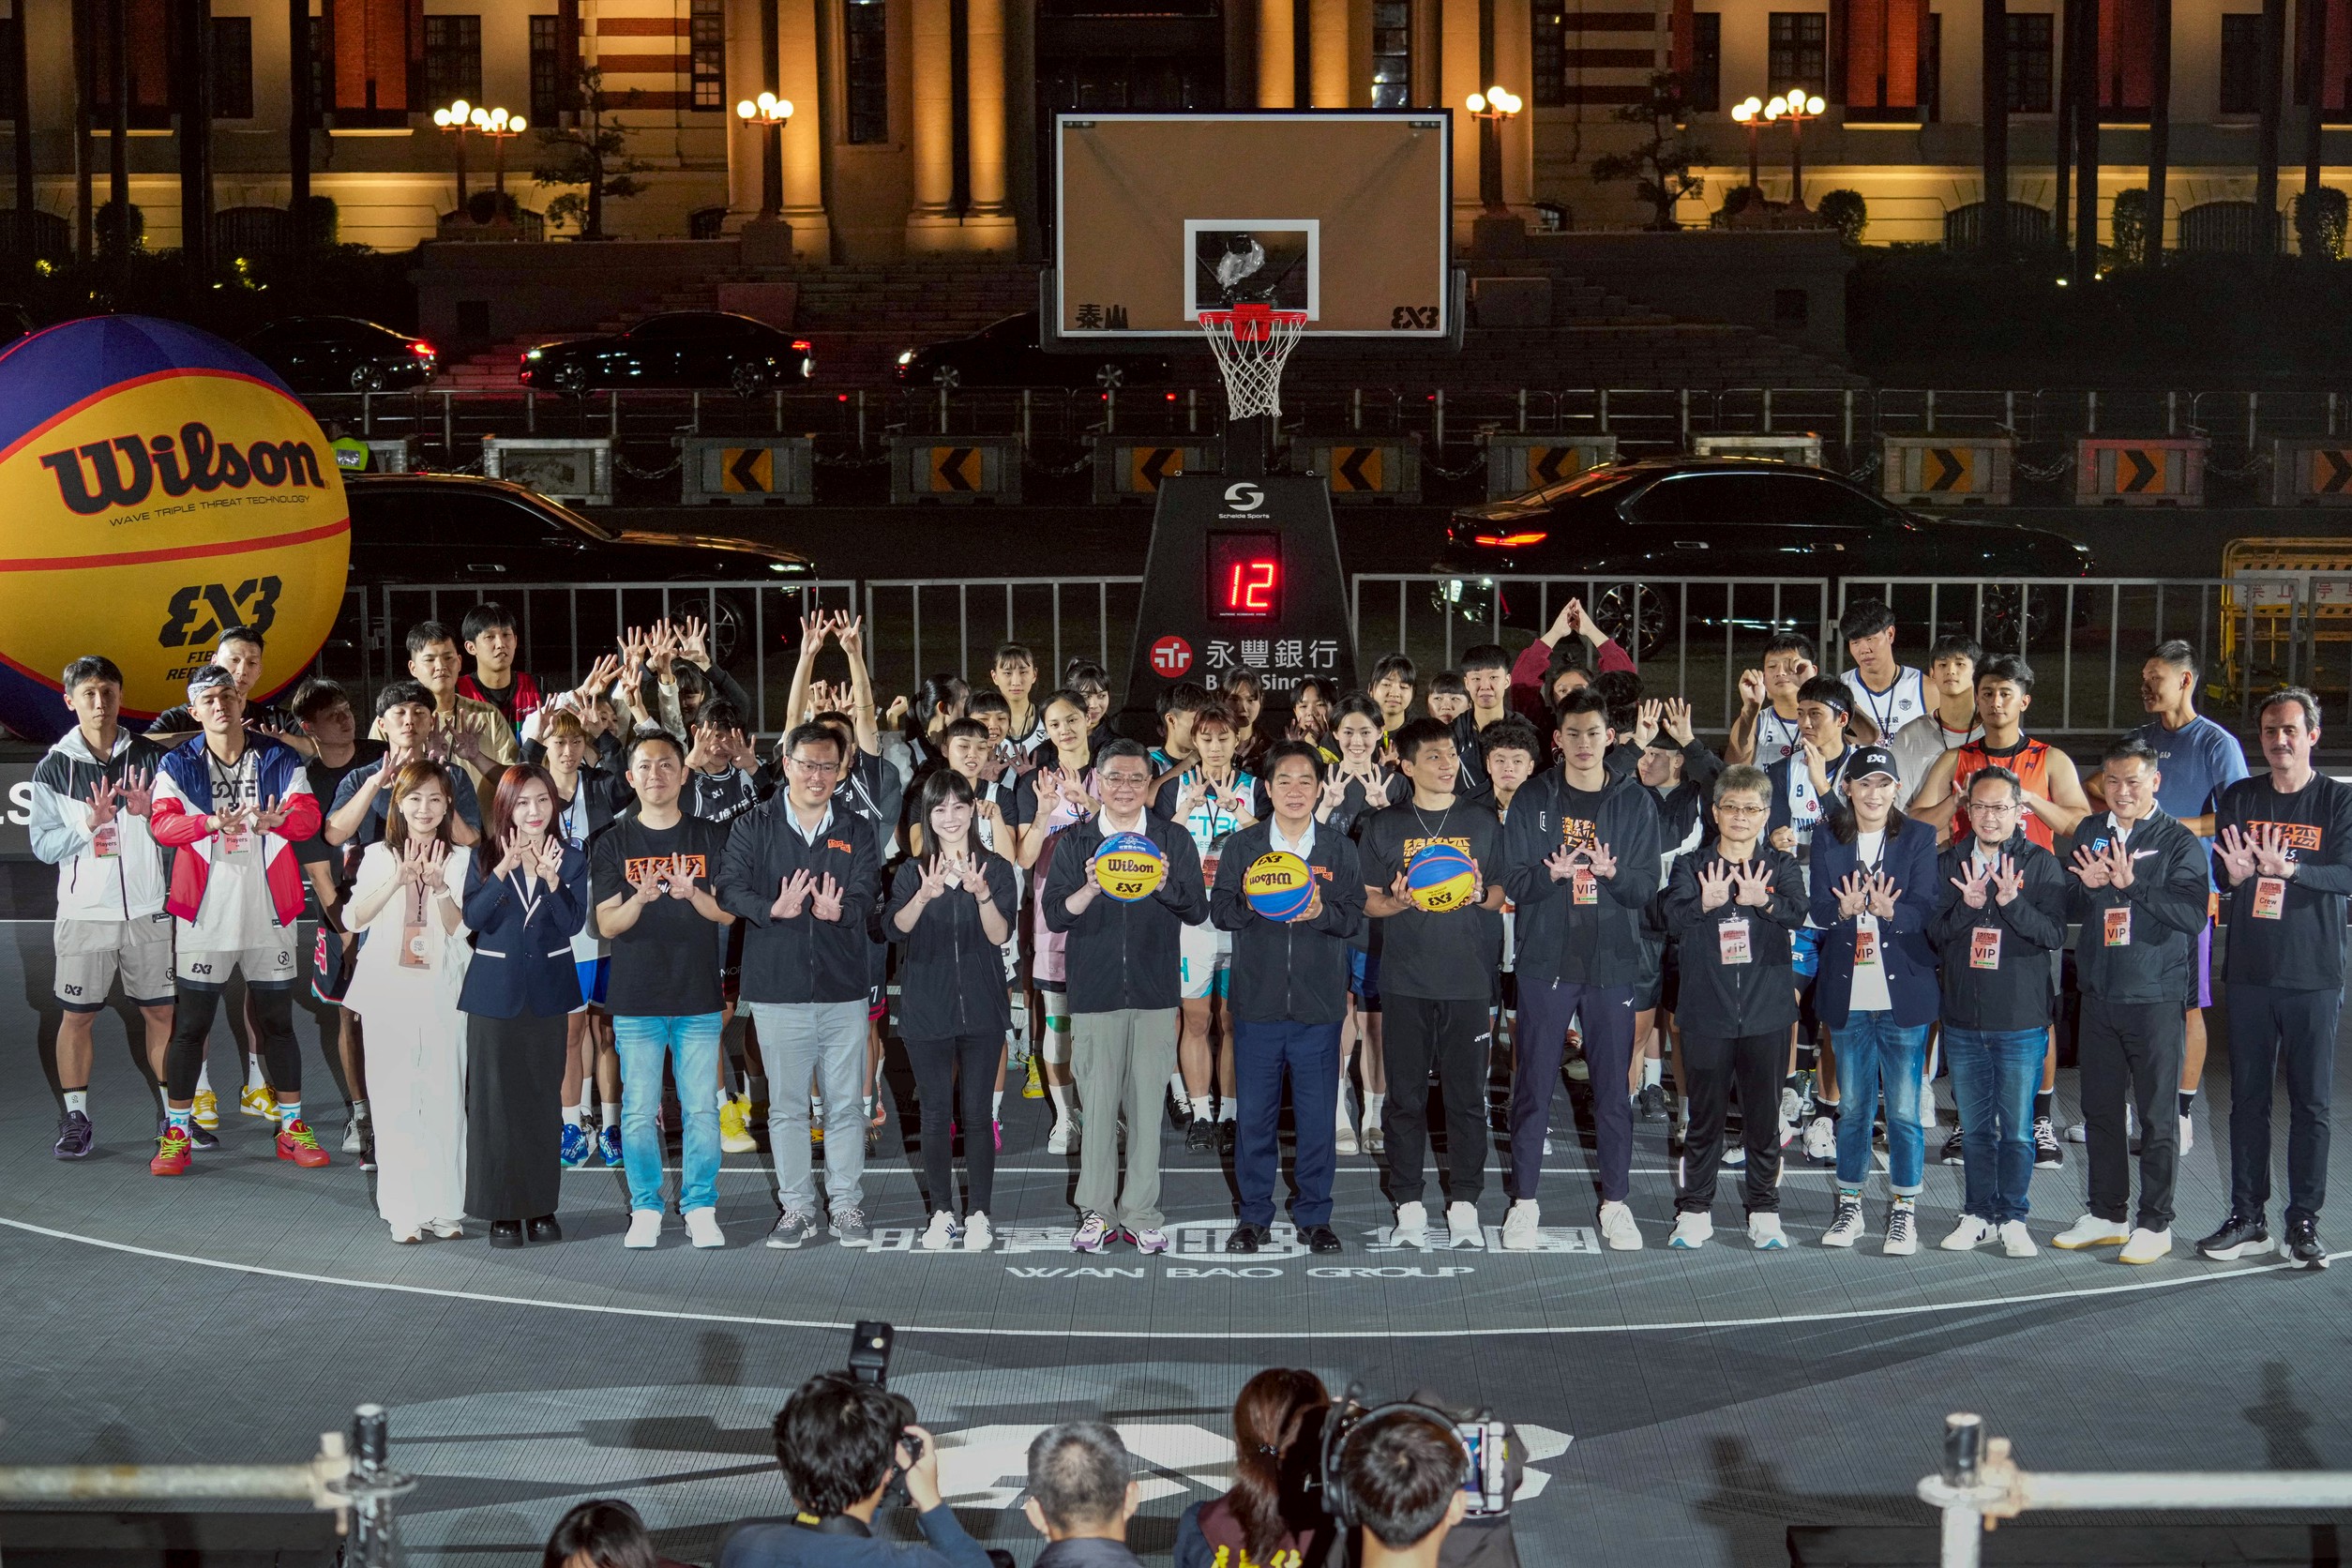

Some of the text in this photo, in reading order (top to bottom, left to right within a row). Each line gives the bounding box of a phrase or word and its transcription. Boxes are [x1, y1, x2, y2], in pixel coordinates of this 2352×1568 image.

[1078, 304, 1128, 329] 泰山
[38, 422, 325, 516] Wilson
[109, 495, 310, 526] WAVE TRIPLE THREAT TECHNOLOGY
[1230, 563, 1274, 608] 12
[1206, 640, 1338, 669] 永豐銀行
[1796, 784, 1804, 798] 9
[1108, 858, 1154, 873] Wilson
[1249, 872, 1292, 885] Wilson
[1576, 883, 1598, 894] VIP
[2259, 897, 2277, 905] Crew
[2107, 927, 2126, 939] VIP
[1855, 947, 1874, 958] VIP
[1974, 947, 1996, 958] VIP
[870, 985, 879, 1003] 7
[1004, 1266, 1475, 1278] WAN BAO GROUP
